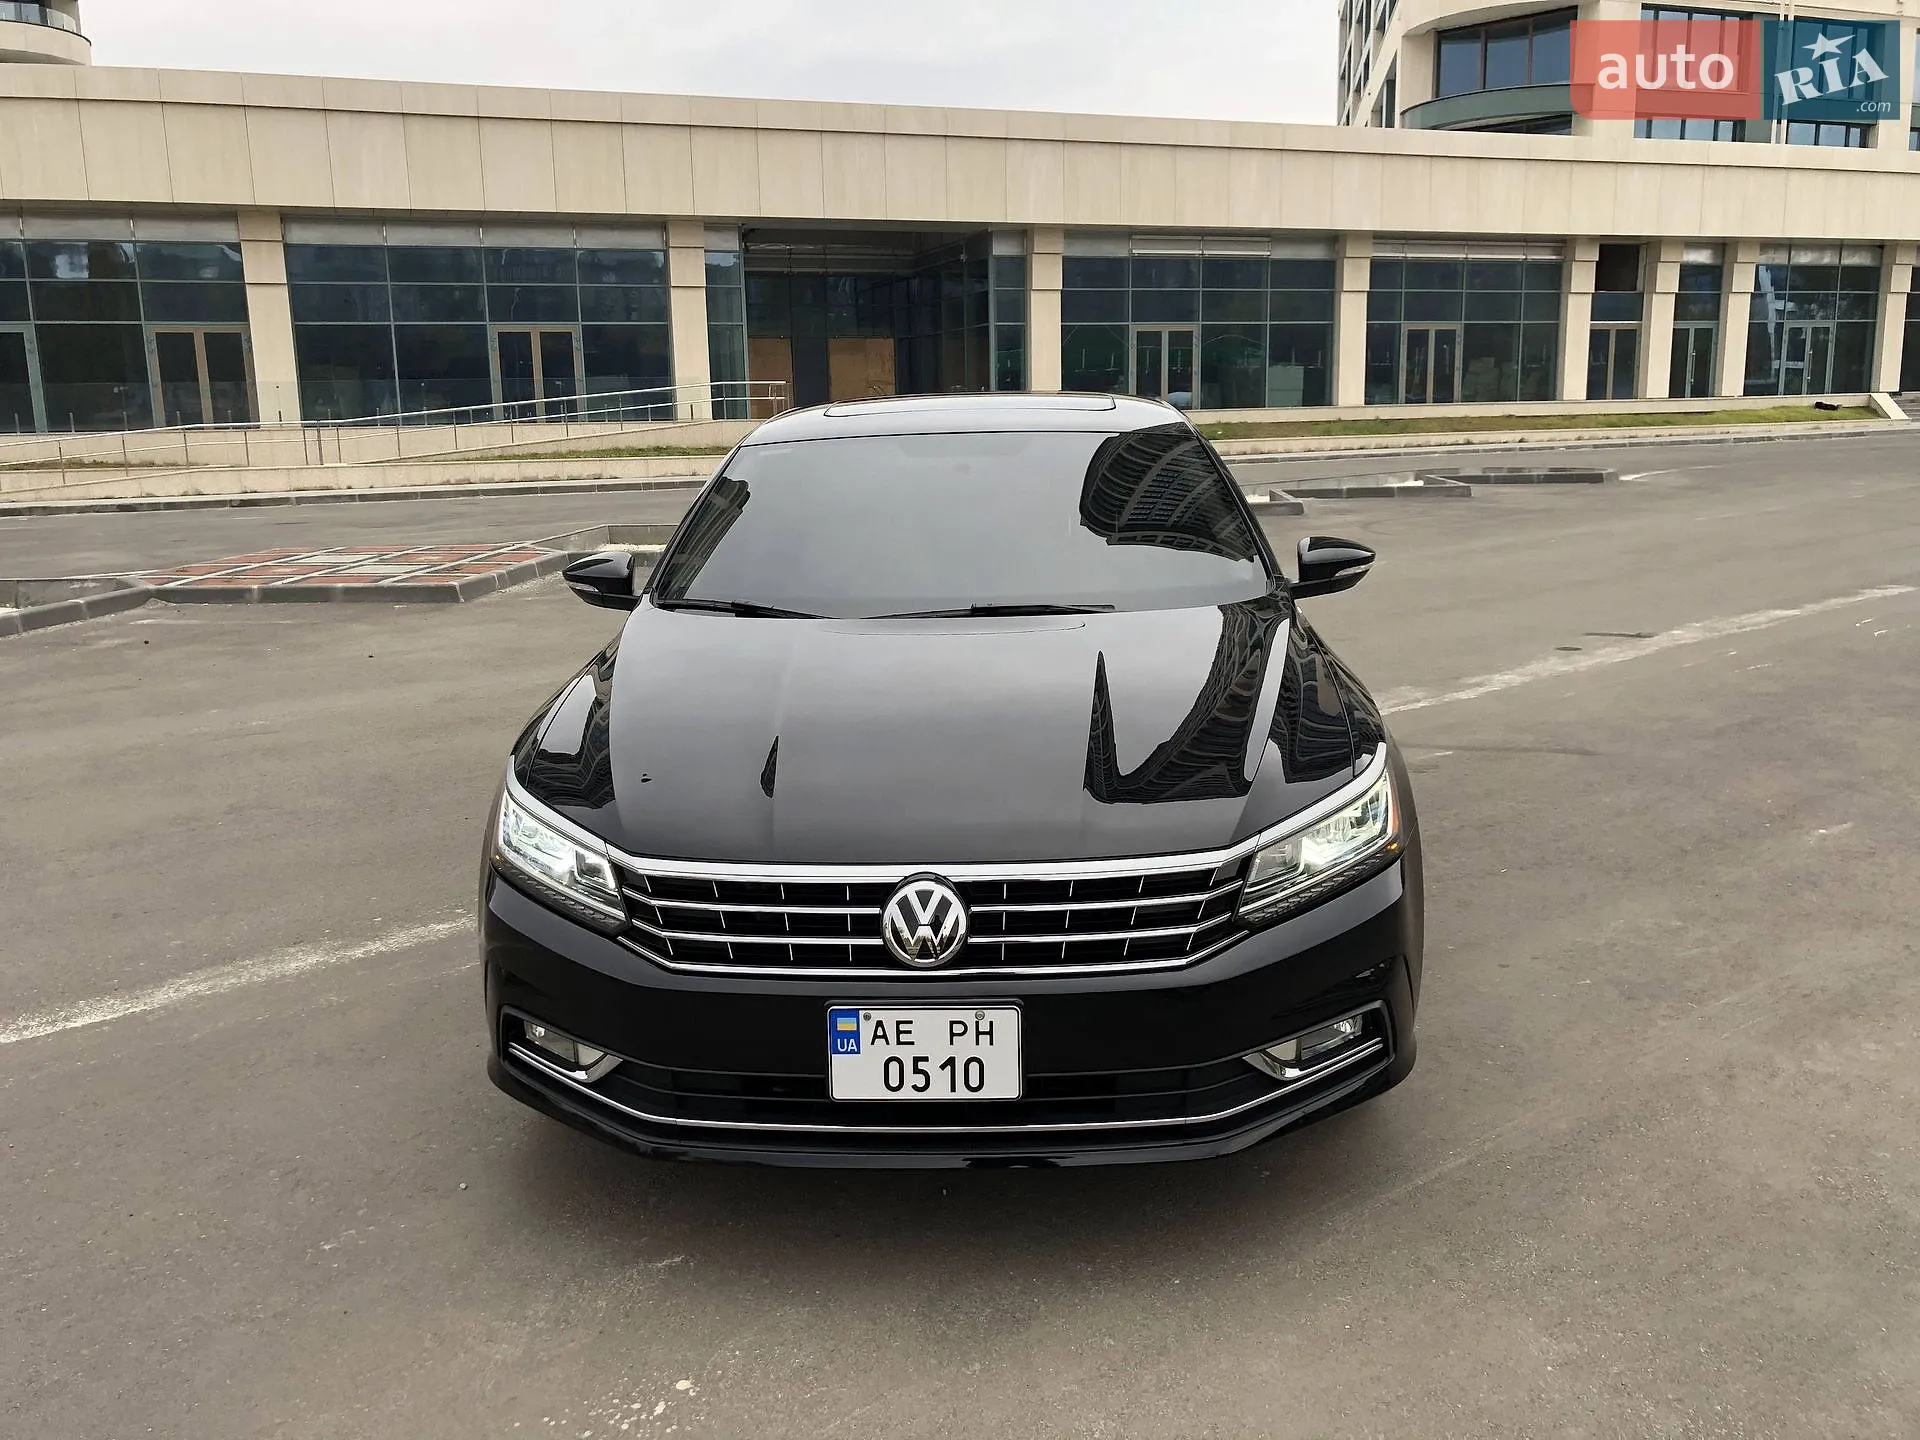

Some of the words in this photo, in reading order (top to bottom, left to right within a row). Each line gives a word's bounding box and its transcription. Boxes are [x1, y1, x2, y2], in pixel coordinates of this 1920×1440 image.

[837, 1038, 858, 1052] UA
[870, 1019, 915, 1046] AE
[949, 1019, 994, 1046] PH
[883, 1055, 985, 1093] 0510
